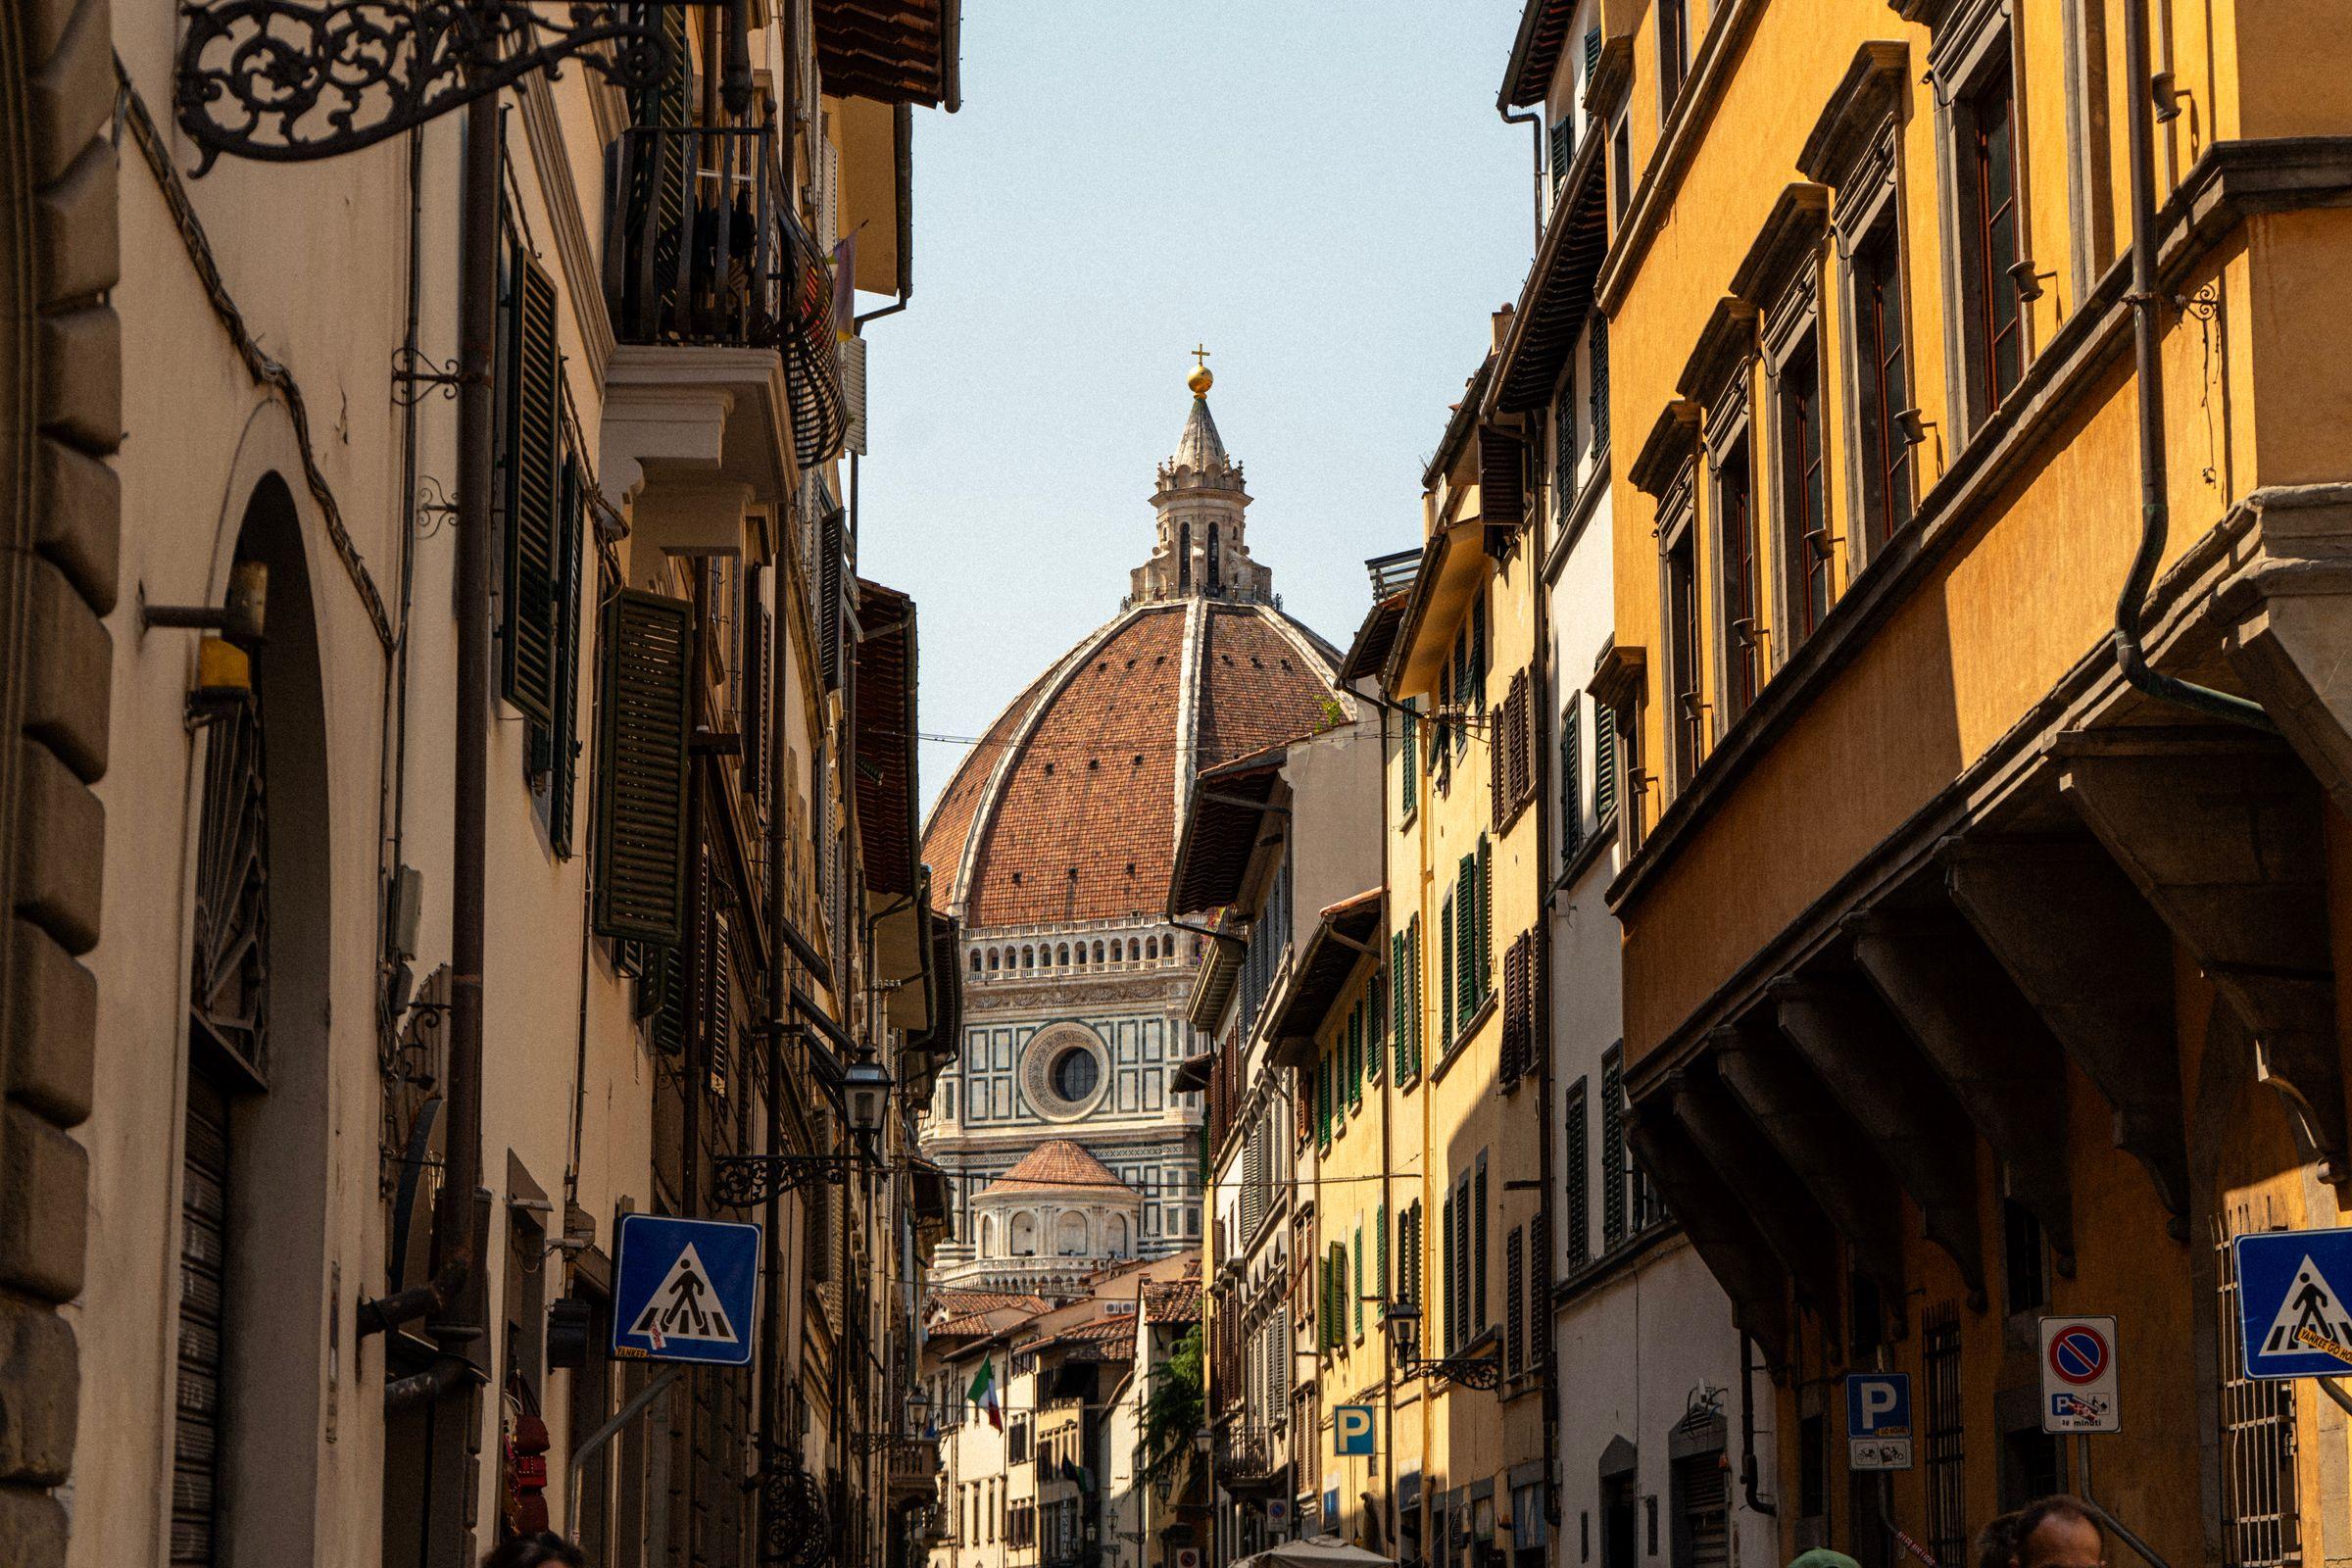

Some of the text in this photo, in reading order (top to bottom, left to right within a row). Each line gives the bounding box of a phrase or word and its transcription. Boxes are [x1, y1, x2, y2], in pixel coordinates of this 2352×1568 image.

[2302, 1330, 2352, 1363] YANKEE GO HO
[1861, 1382, 1897, 1429] P
[2057, 1396, 2069, 1413] P
[1338, 1409, 1370, 1451] P
